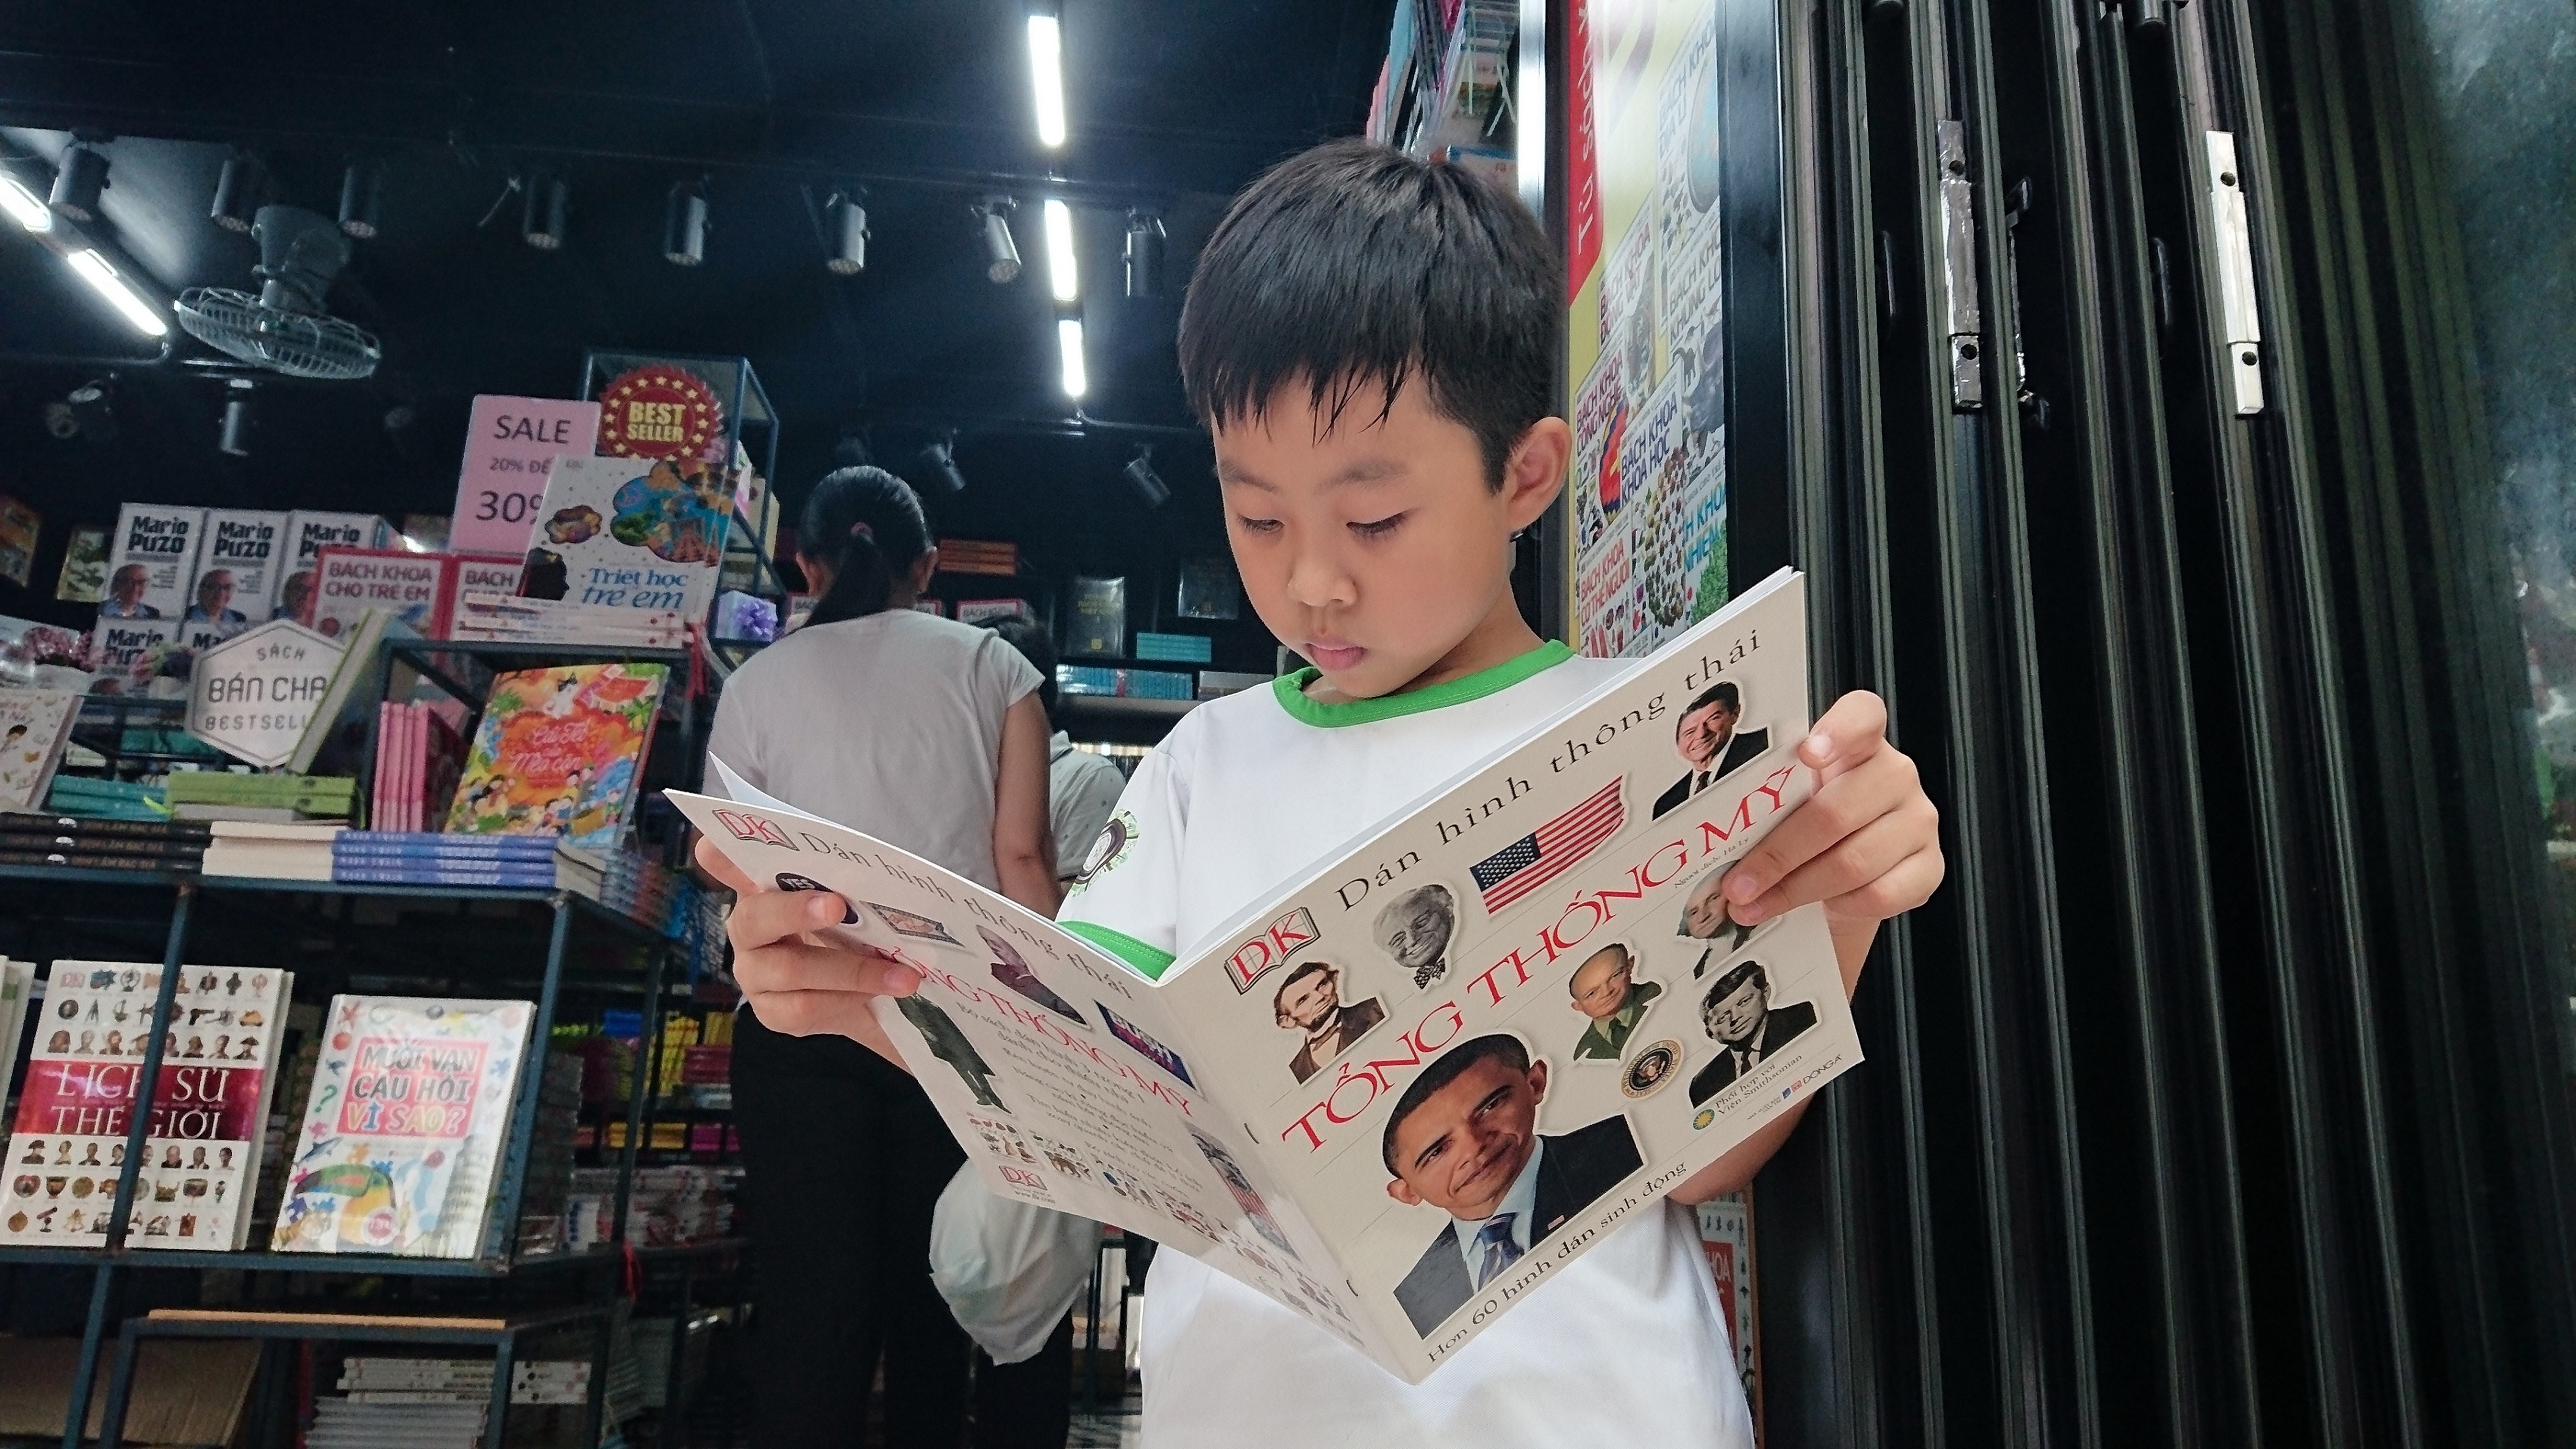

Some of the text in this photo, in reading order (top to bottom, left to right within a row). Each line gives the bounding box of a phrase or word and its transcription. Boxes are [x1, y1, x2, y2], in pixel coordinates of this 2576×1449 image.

[1600, 349, 1623, 400] KHOA
[629, 402, 687, 425] BEST
[1648, 391, 1677, 447] KHOA
[494, 415, 571, 444] SALE
[627, 423, 684, 442] SELLER
[489, 457, 523, 473] 20%
[1622, 428, 1670, 504] KHOA HỌC
[132, 515, 189, 535] Mario
[218, 521, 275, 541] Mario
[304, 523, 361, 543] Mario
[128, 533, 186, 553] Puzo
[213, 538, 270, 559] Puzo
[1602, 537, 1624, 578] KHOA
[382, 564, 432, 581] KHOA
[325, 581, 363, 598] CHO
[404, 585, 430, 601] EM
[632, 590, 684, 609] em
[257, 642, 306, 661] SÁCH
[208, 671, 264, 703] BÁN
[1335, 850, 1422, 912] Dán
[1435, 776, 1533, 846] hình
[1550, 692, 1667, 773] thông
[1684, 629, 1762, 691] thái
[718, 809, 787, 843] DK
[799, 831, 872, 868] Dán
[875, 854, 956, 904] hình
[781, 878, 815, 889] YES
[1232, 913, 1310, 985] DK
[1281, 1001, 1465, 1153] TỔNG
[1466, 839, 1690, 1007] THỐNG
[1696, 764, 1797, 859] MỸ
[977, 987, 1128, 1078] THỐNG
[1714, 1086, 1737, 1109] Phối
[1717, 1095, 1742, 1115] Viện
[1743, 1055, 1803, 1099] Smithsonian
[1427, 1161, 1687, 1364] Hơn 60 hình dán sinh động
[1706, 1251, 1731, 1283] HOA
